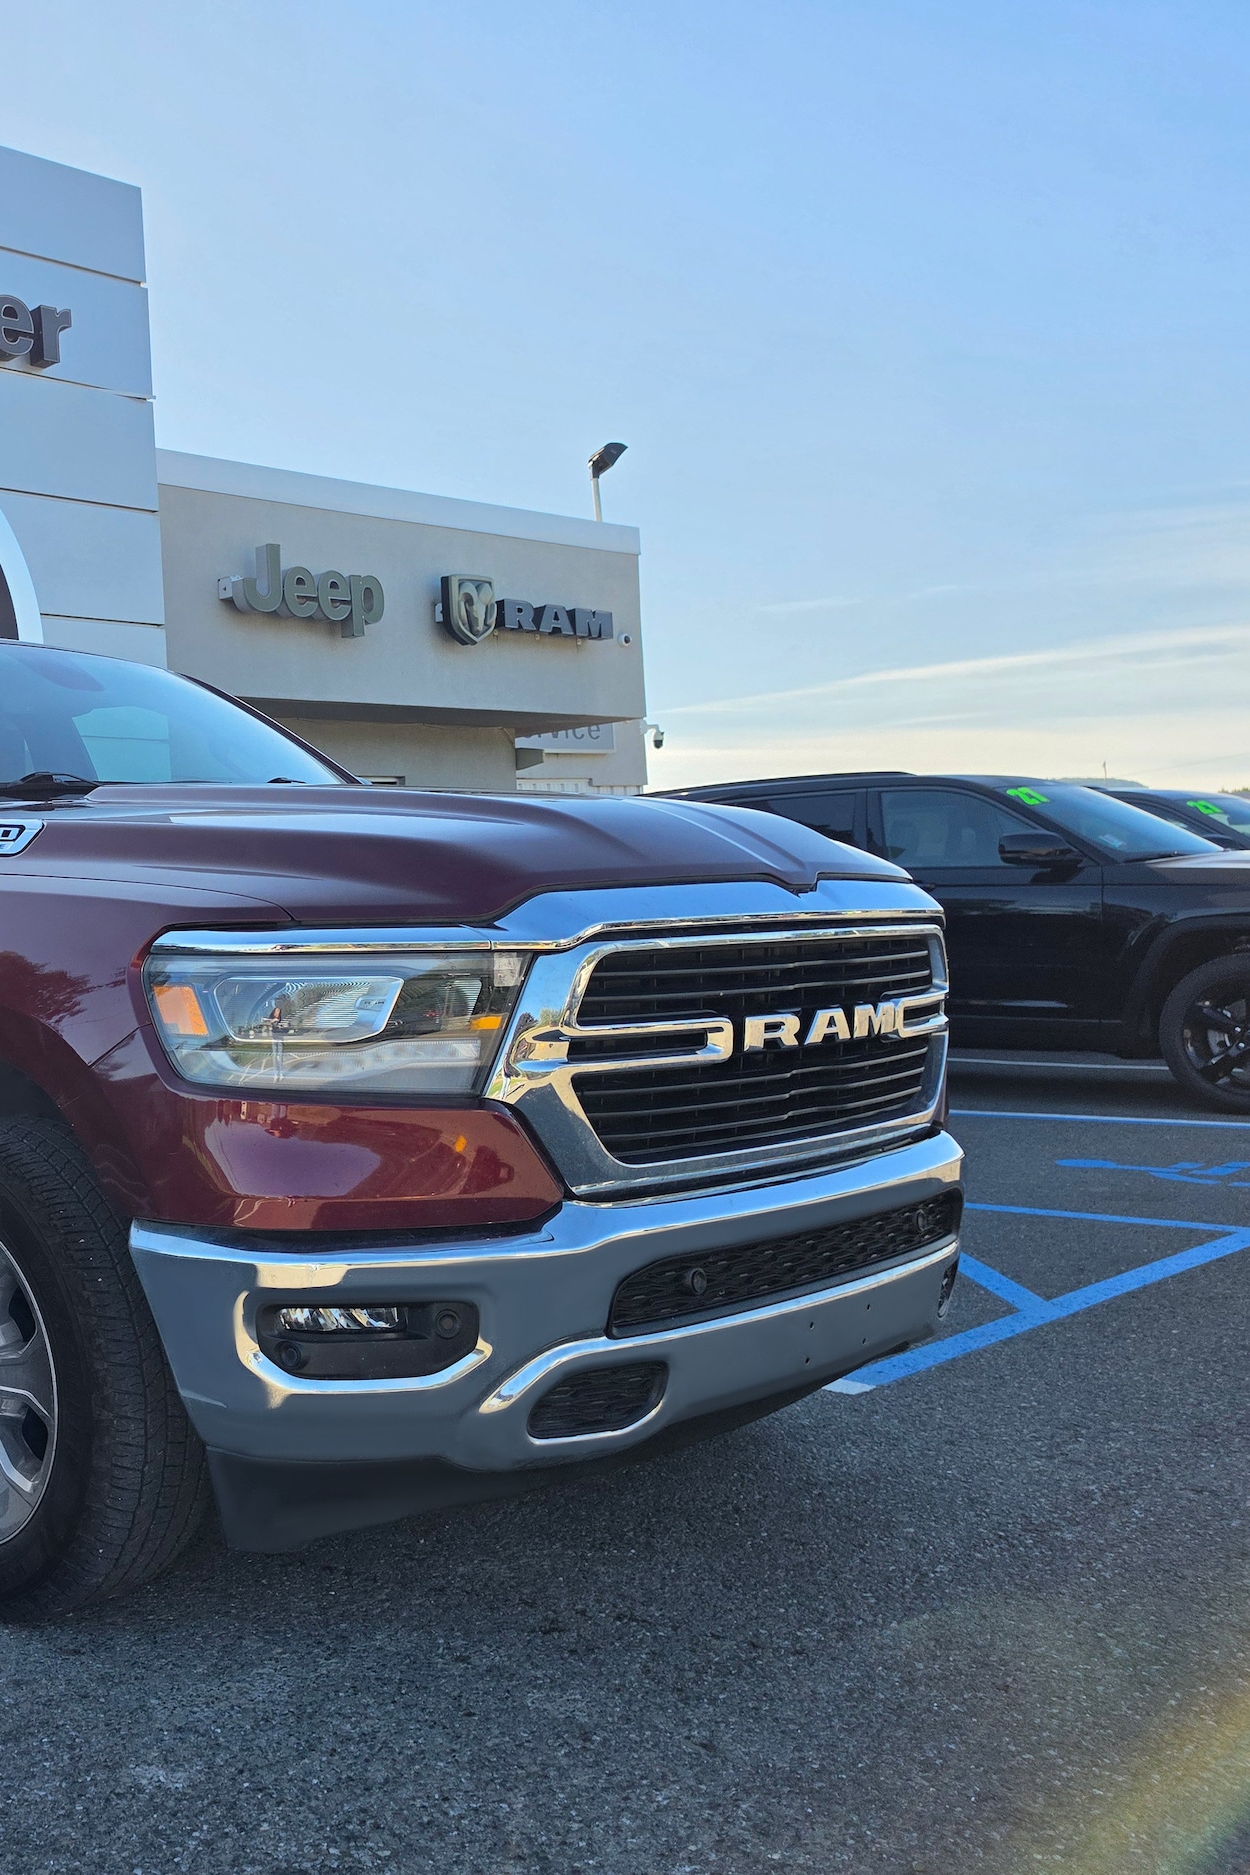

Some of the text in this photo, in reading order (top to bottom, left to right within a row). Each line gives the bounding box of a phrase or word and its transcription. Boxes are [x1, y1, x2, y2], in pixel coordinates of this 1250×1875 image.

[232, 543, 385, 638] Jeep
[496, 598, 614, 640] RAM
[744, 1001, 897, 1052] RAM
